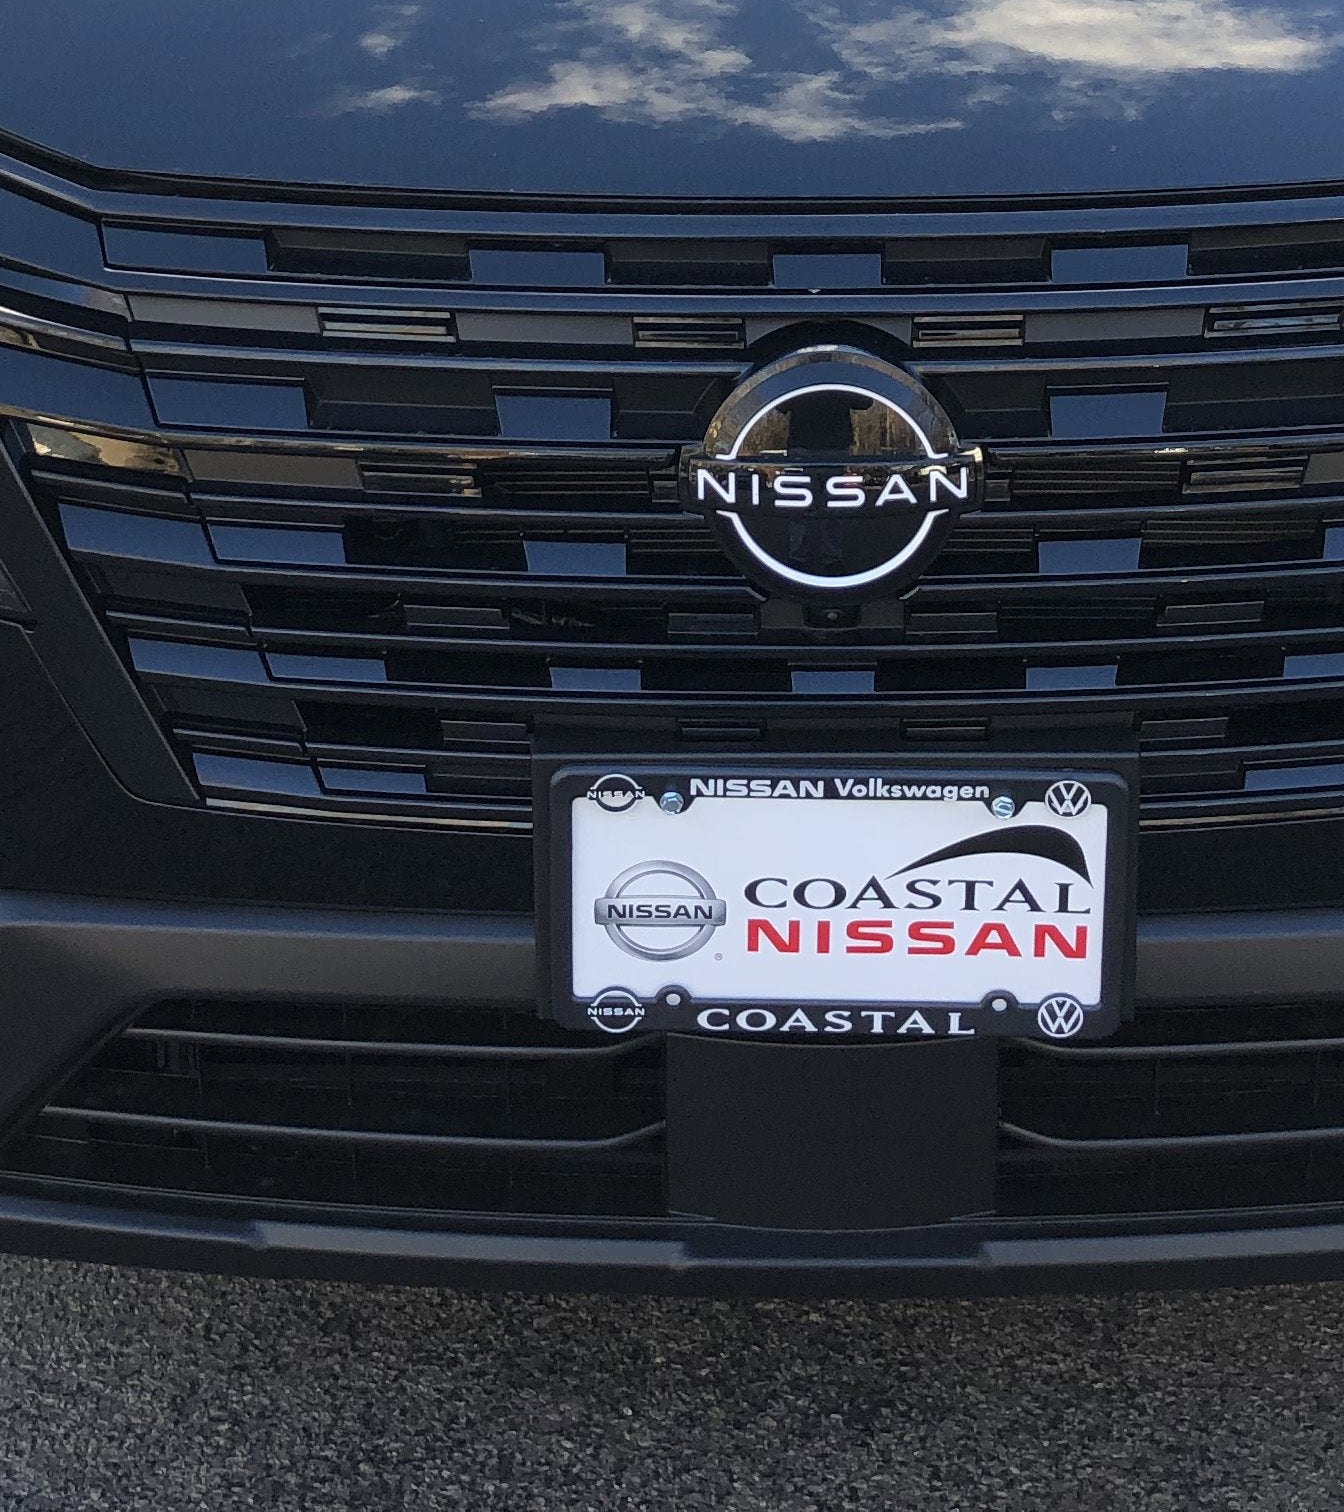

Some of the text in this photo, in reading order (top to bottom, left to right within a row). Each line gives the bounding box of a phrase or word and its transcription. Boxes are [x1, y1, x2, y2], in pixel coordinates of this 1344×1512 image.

[696, 466, 969, 508] NISSAN
[587, 790, 645, 799] NISSAN
[690, 777, 991, 801] NISSAN Volkswagen
[743, 874, 1092, 915] COASTAL
[607, 902, 713, 921] NISSAN
[747, 919, 1088, 959] NISSAN
[587, 1007, 645, 1016] NISSAN
[697, 1008, 976, 1036] COASTAL
